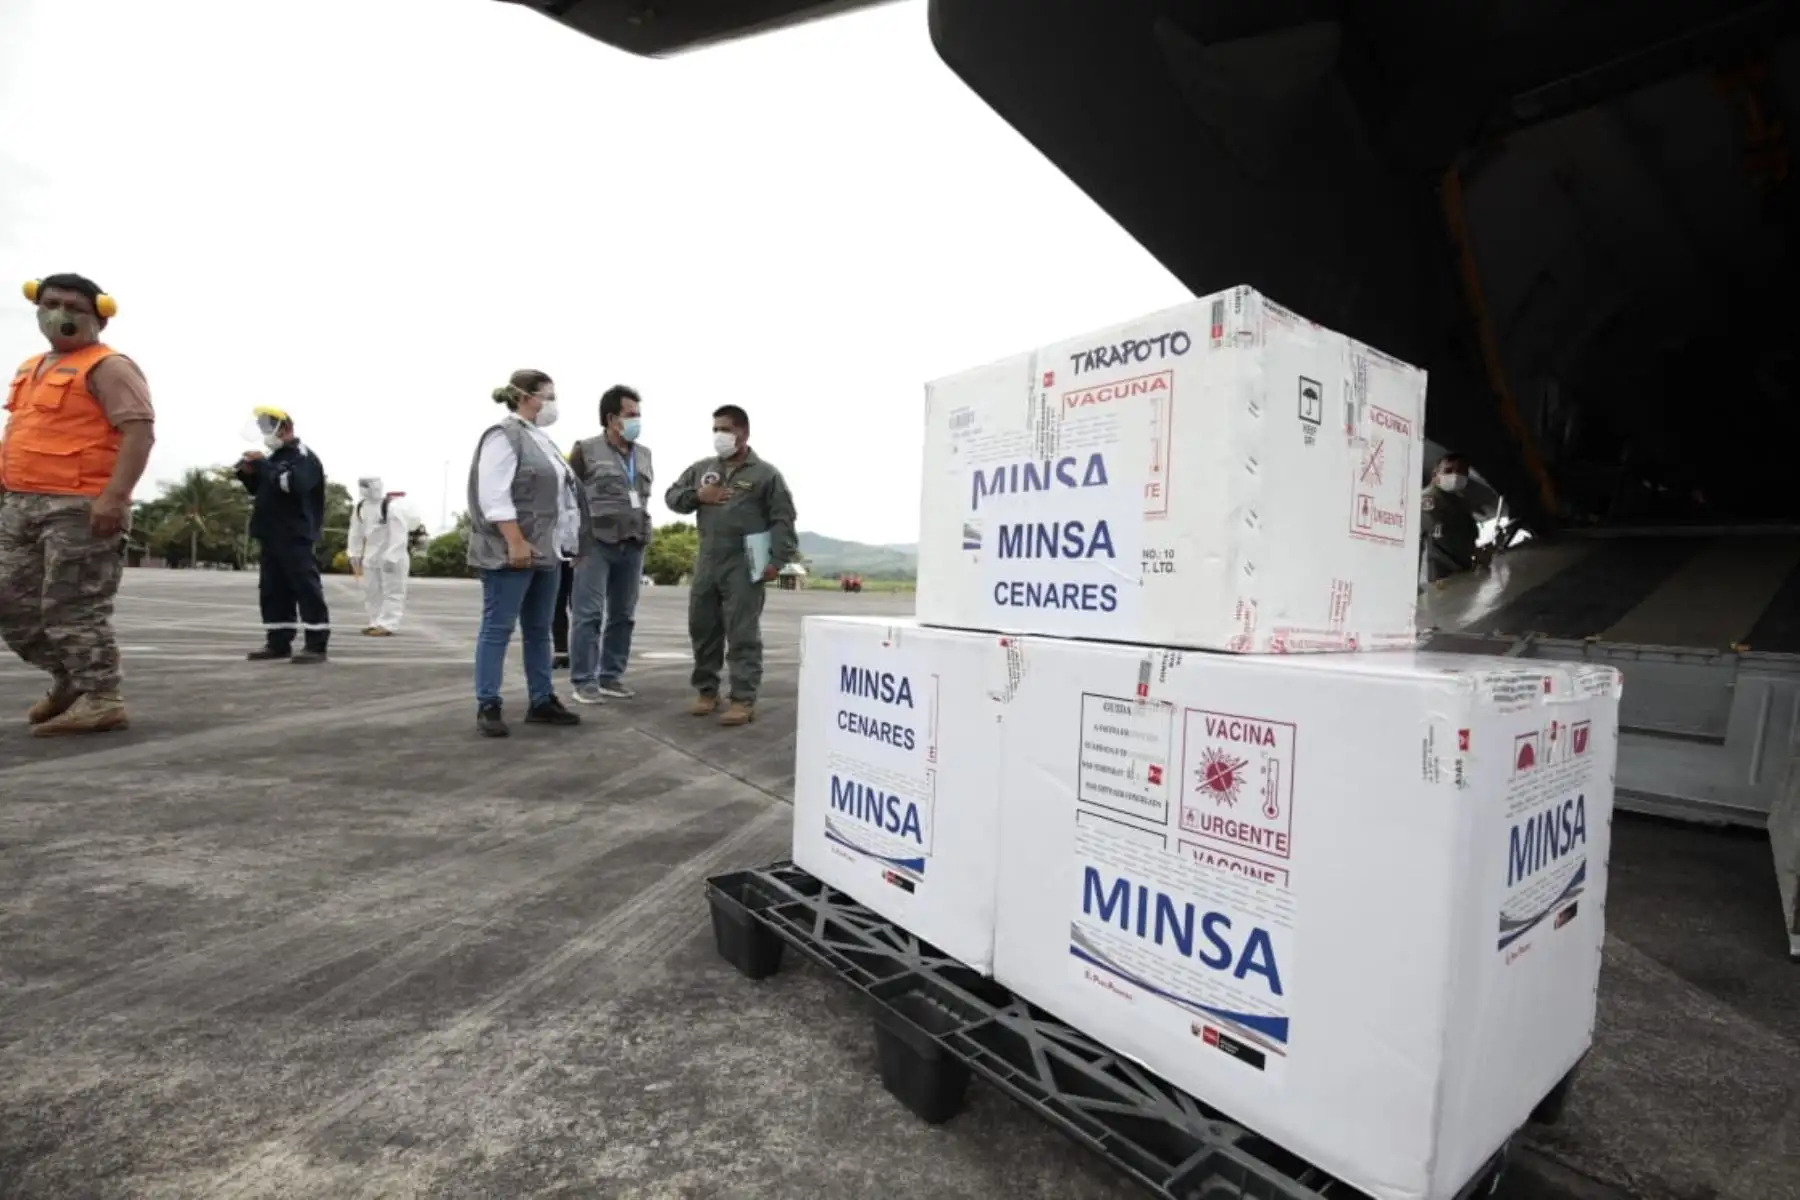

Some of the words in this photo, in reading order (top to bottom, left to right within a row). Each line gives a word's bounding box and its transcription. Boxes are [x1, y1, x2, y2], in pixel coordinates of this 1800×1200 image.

[1070, 330, 1191, 375] TARAPOTO
[1066, 376, 1168, 409] VACUNA
[998, 519, 1116, 559] MINSA
[993, 581, 1118, 612] CENARES
[840, 664, 914, 709] MINSA
[837, 709, 915, 750] CENARES
[1205, 716, 1276, 748] VACINA
[830, 774, 923, 845] MINSA
[1200, 814, 1288, 852] URGENTE
[1507, 794, 1586, 887] MINSA
[1083, 865, 1284, 997] MINSA
